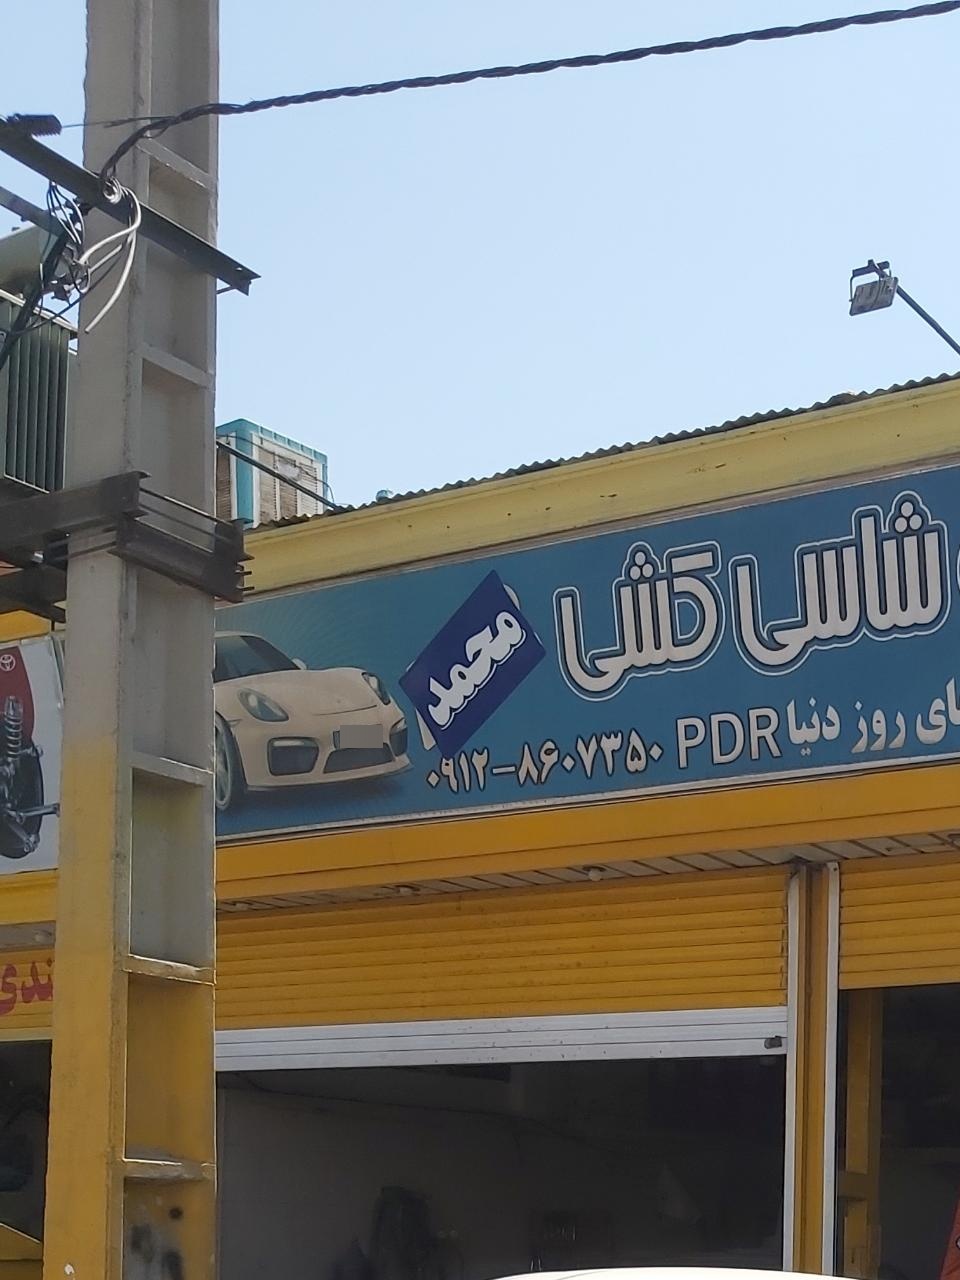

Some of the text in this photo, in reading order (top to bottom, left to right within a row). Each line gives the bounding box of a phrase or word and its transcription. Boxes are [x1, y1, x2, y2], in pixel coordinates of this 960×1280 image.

[556, 547, 721, 696] کشی
[733, 498, 943, 670] شاسی
[426, 607, 527, 731] محمد
[676, 705, 784, 769] PDR
[786, 697, 840, 756] دنیا
[851, 700, 907, 754] روز
